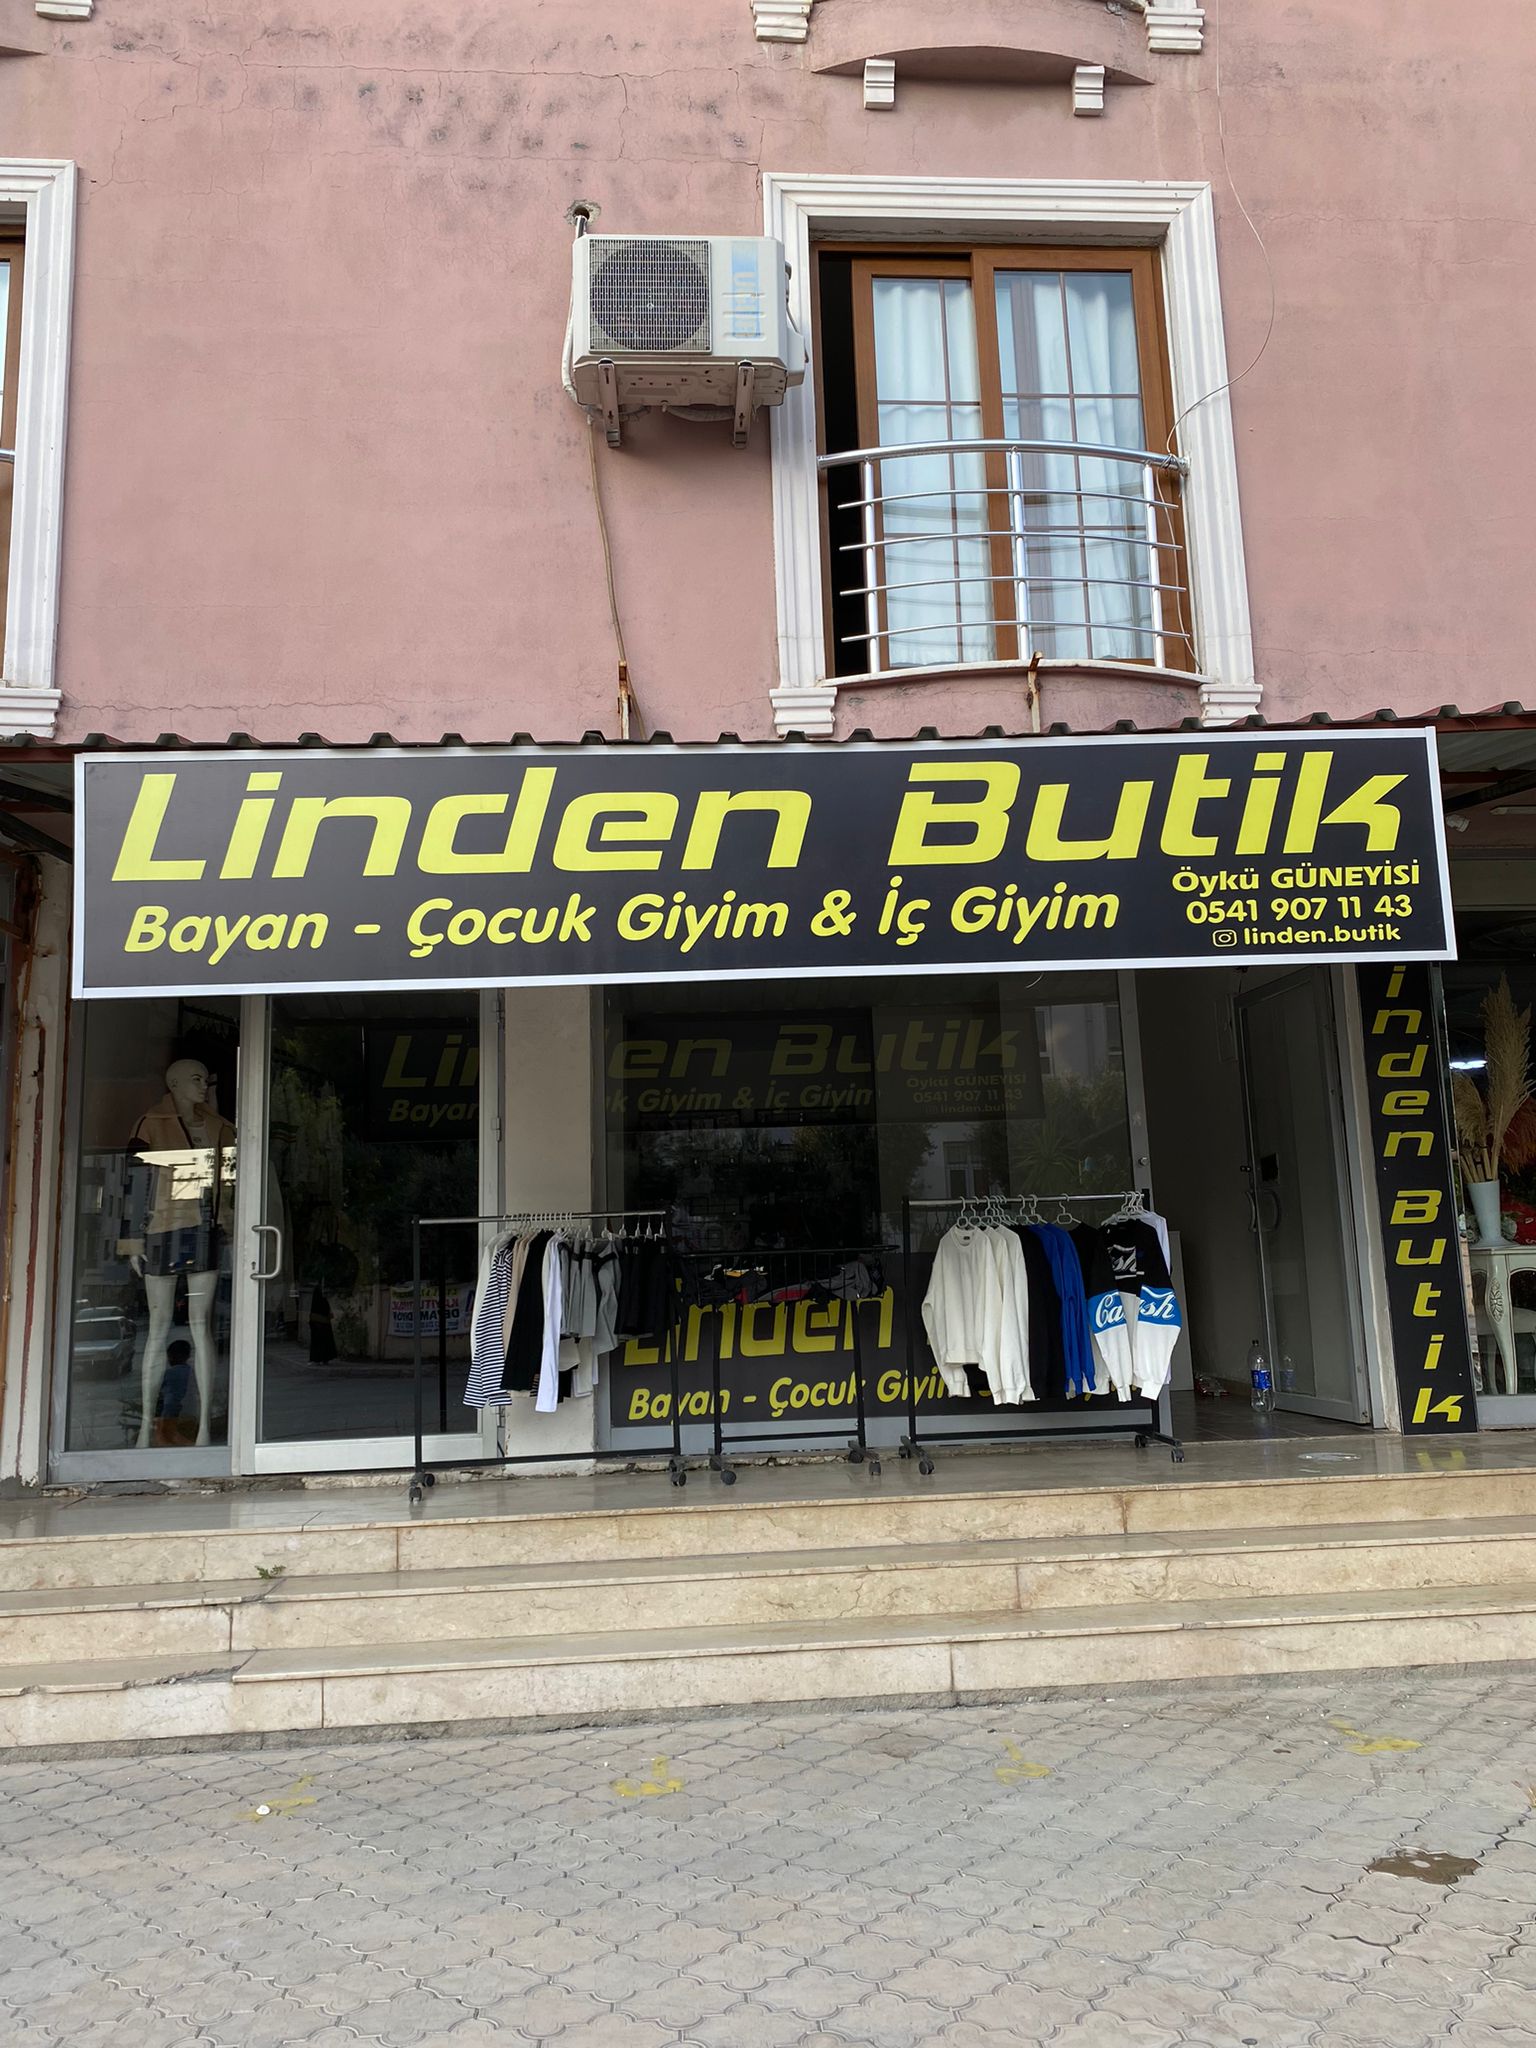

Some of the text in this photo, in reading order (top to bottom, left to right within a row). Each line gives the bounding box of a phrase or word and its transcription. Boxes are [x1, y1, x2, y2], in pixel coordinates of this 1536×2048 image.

[111, 751, 1408, 881] Linden Butik
[1171, 859, 1420, 898] Öykü GÜNEYİSİ
[123, 875, 1120, 966] Bayan - Çocuk Giyim & İç Giyim
[1185, 894, 1413, 925] 0541 907 11 43
[1243, 923, 1402, 946] linden.butik
[769, 1019, 1021, 1075] Butik
[1371, 964, 1433, 1159] inden
[636, 1085, 723, 1118] Giyim
[1388, 1189, 1465, 1426] Butik
